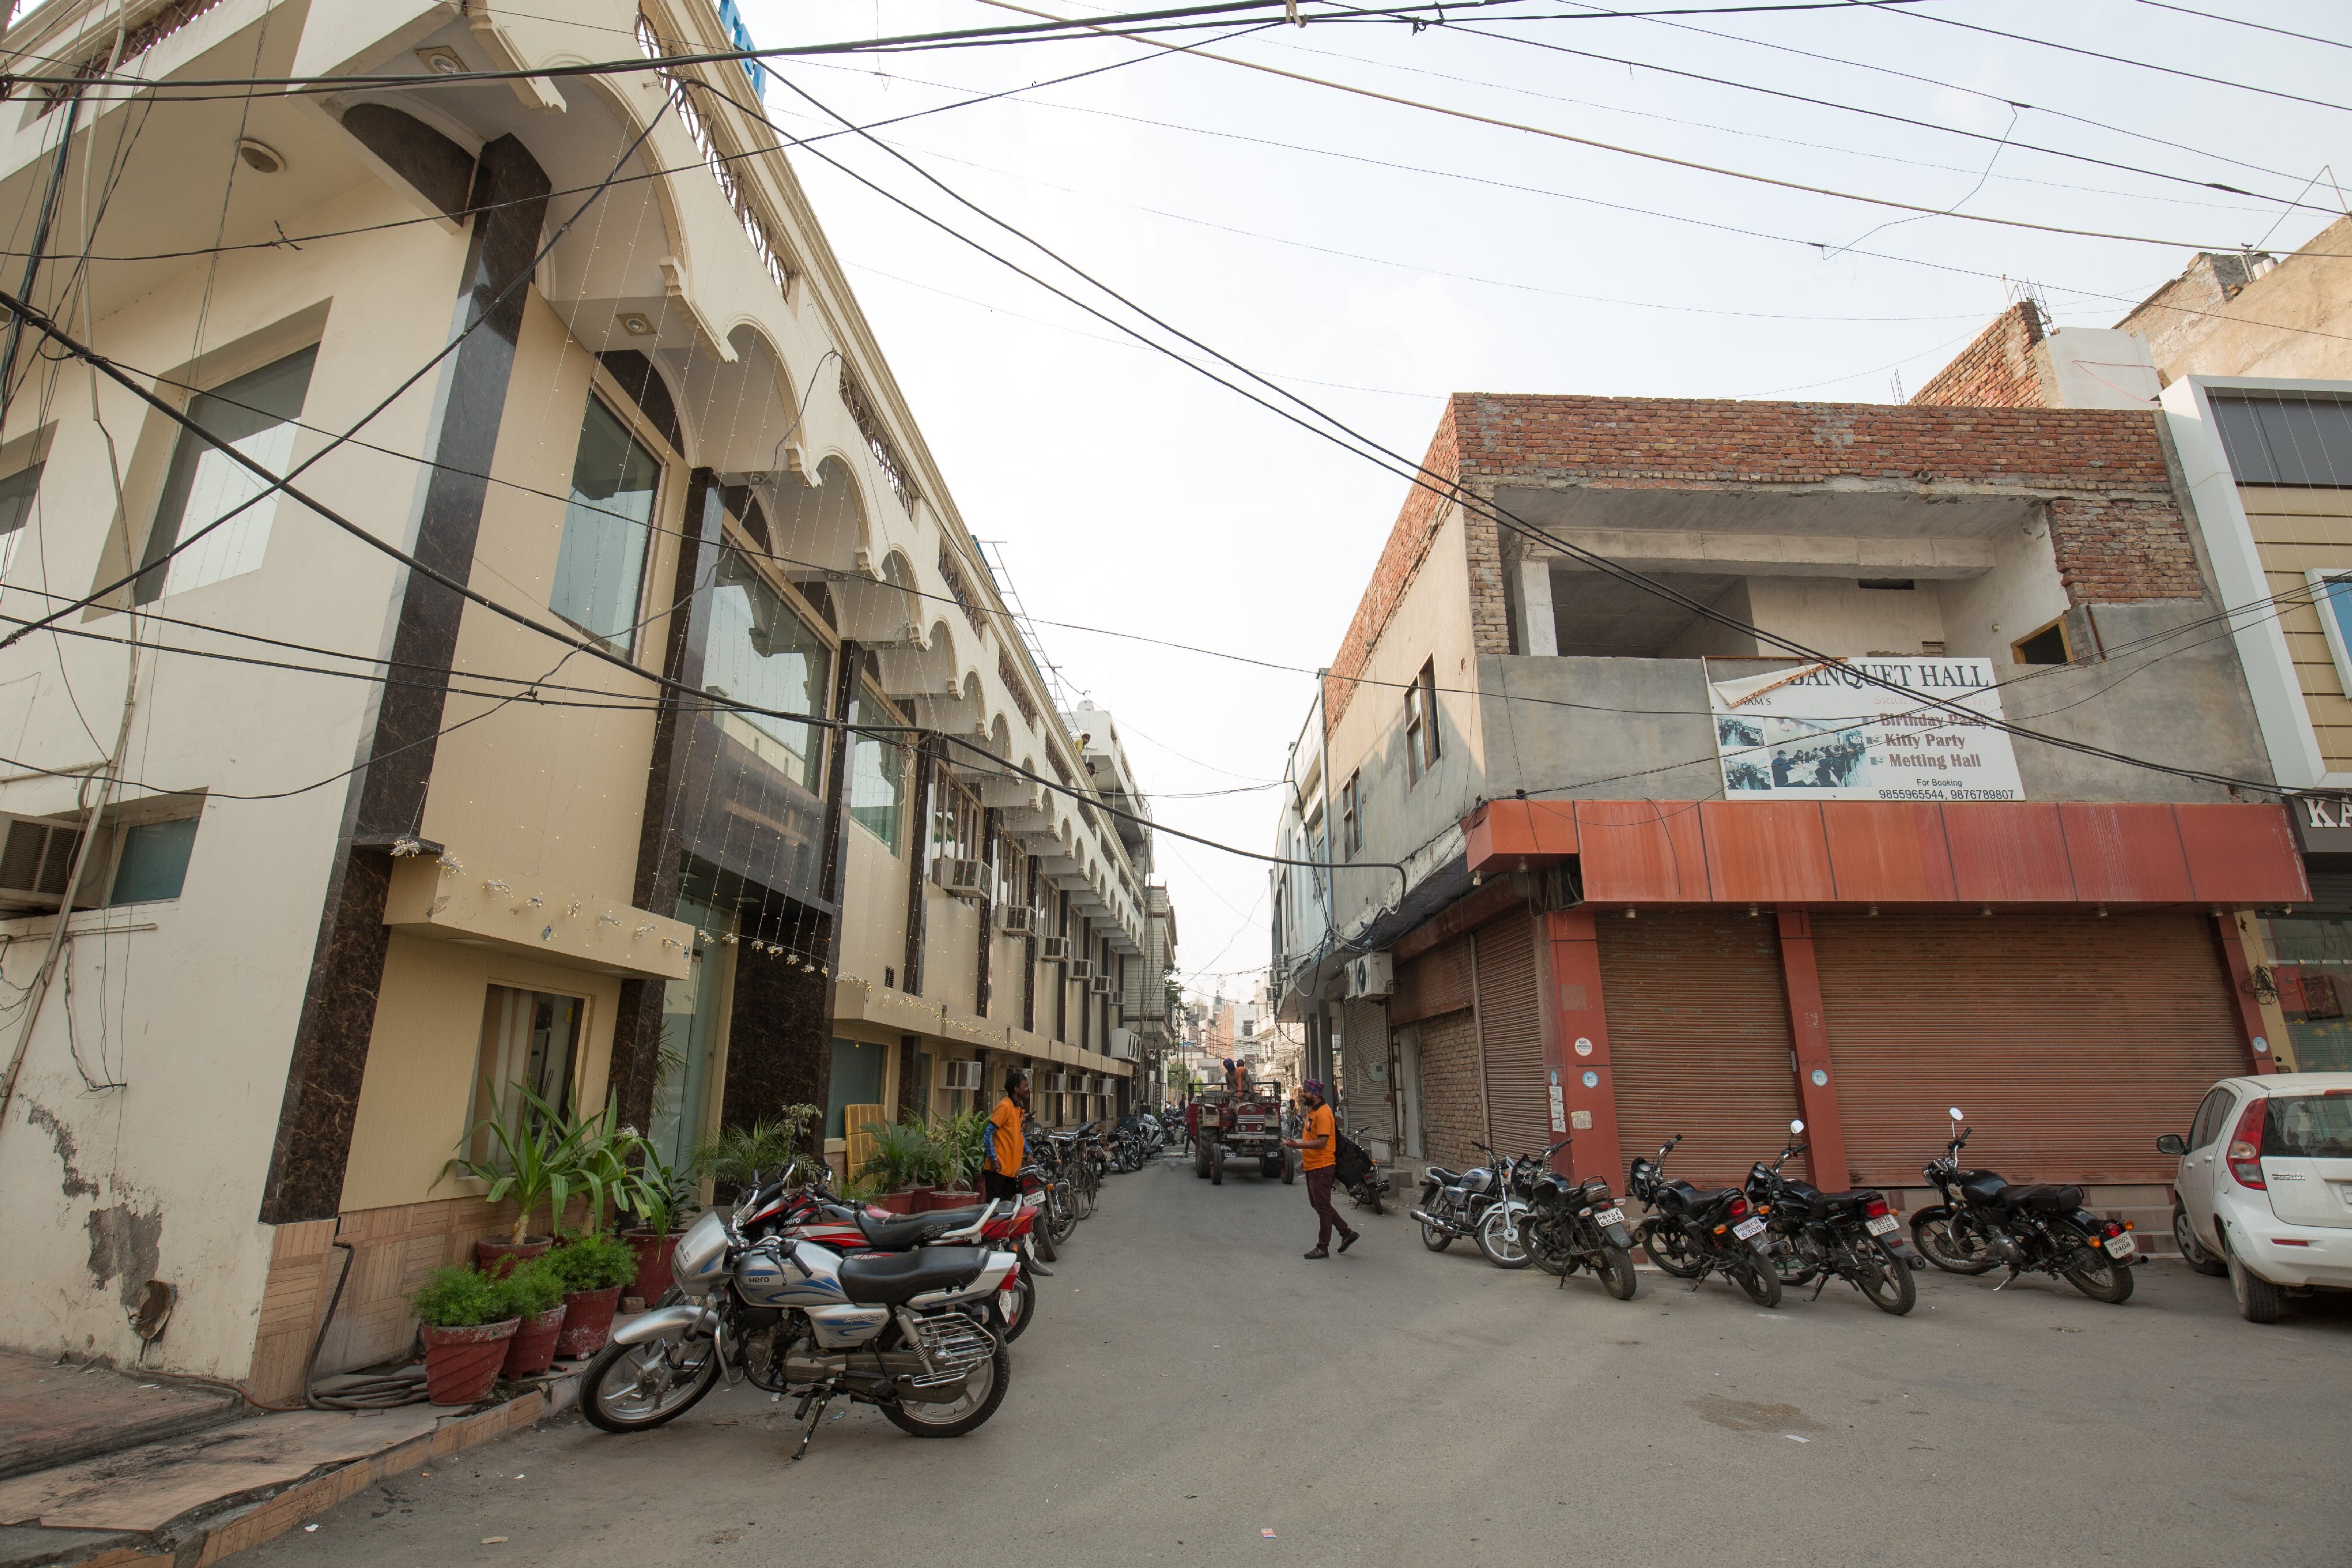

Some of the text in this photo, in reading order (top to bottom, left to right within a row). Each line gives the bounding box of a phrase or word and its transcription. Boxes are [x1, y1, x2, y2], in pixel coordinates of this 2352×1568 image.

[1918, 665, 1989, 687] HALL
[1874, 694, 1907, 709] Special
[1973, 696, 1987, 706] For
[1879, 713, 1987, 730] Birthday Party
[1885, 733, 1965, 749] Kitty Party
[1889, 754, 1981, 769] Metting Hall
[1932, 779, 1962, 787] Booking
[1879, 789, 2014, 800] 9855965544, 9876789807
[1600, 1216, 1623, 1226] 6556
[1742, 1225, 1762, 1237] 6300
[2113, 1241, 2131, 1254] 7408
